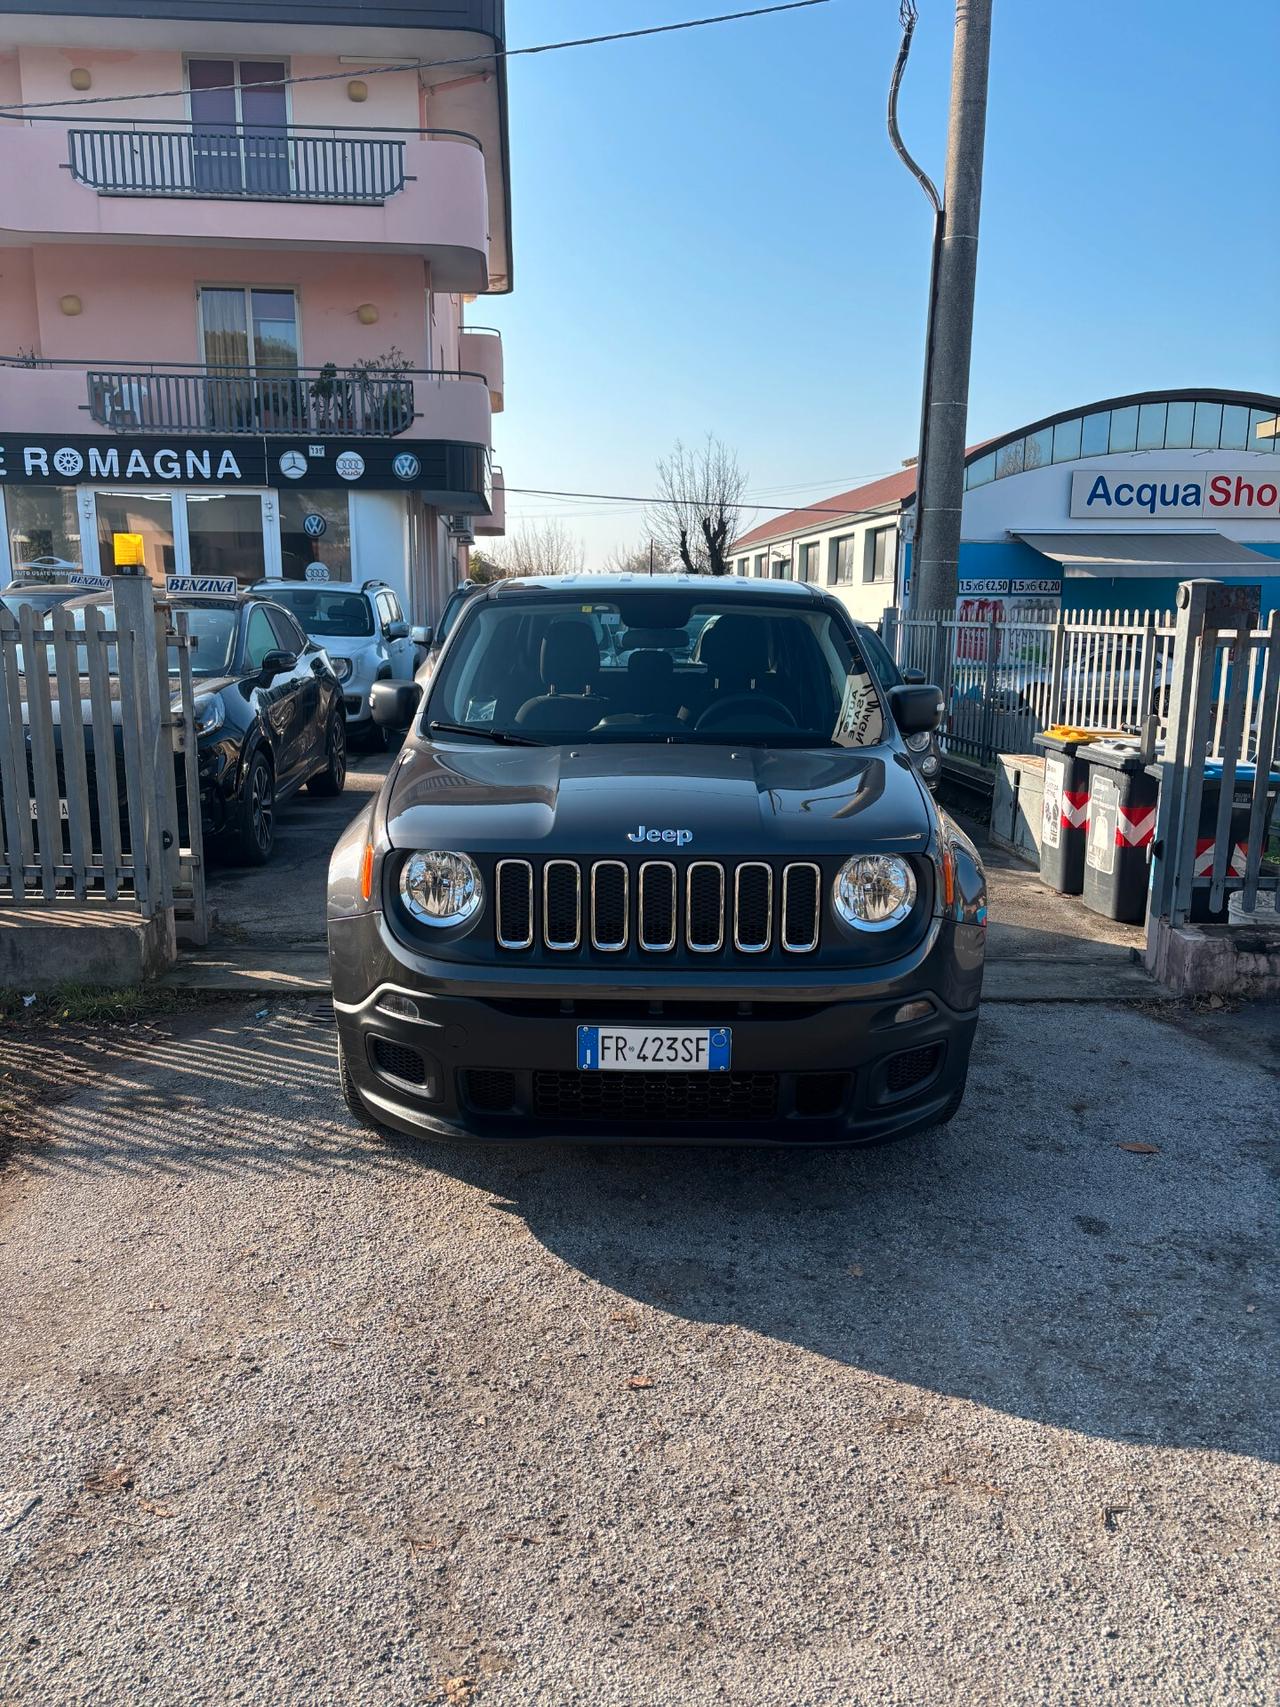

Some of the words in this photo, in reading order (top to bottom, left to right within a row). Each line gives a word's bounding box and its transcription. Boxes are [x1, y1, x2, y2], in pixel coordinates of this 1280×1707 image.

[23, 446, 242, 479] ROMAGNA
[1208, 475, 1280, 514] Sho
[70, 575, 110, 587] BENZINA
[169, 578, 234, 592] BENZINA
[986, 580, 1008, 592] €2,50
[1038, 580, 1060, 592] €2,20
[627, 825, 693, 847] Jeep
